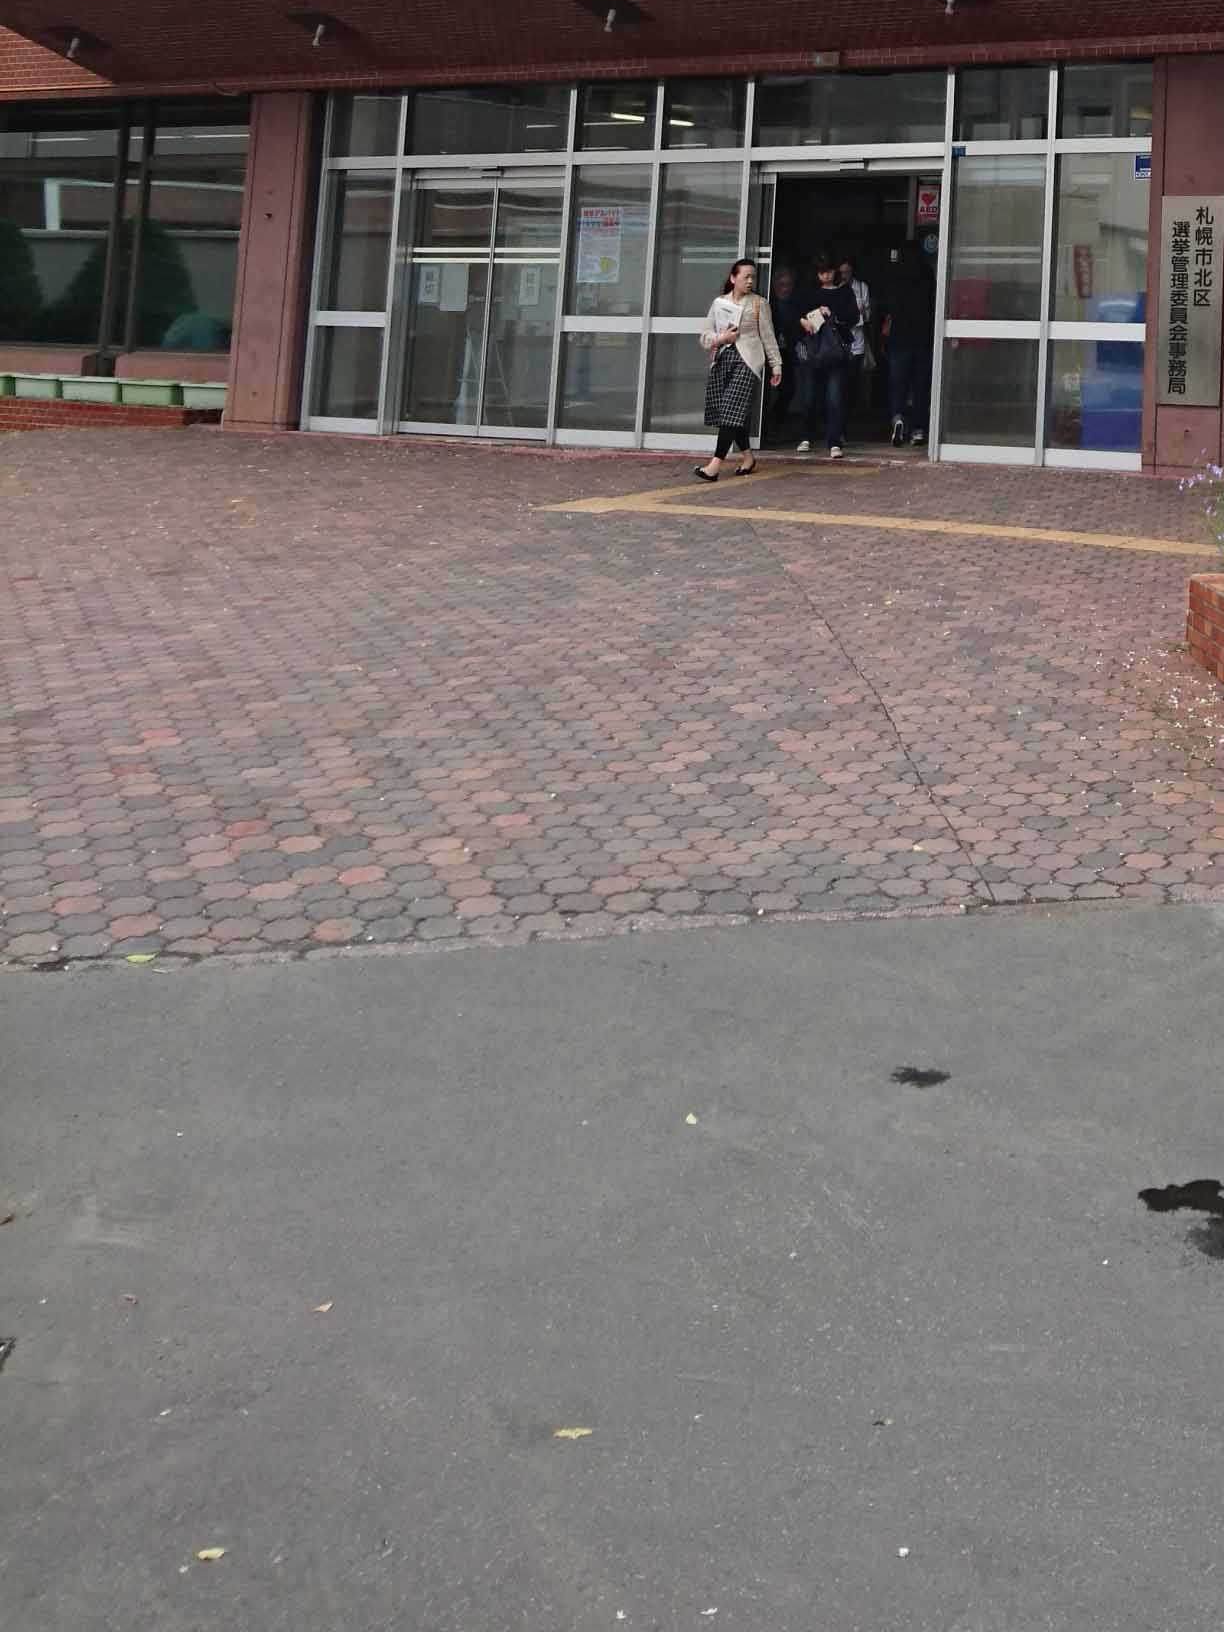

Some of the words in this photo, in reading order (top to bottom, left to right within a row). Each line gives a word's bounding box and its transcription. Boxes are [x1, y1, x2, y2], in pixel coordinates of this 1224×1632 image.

[1167, 220, 1191, 395] 選挙管理委員会事務局
[1193, 206, 1214, 307] 札幌市北区
